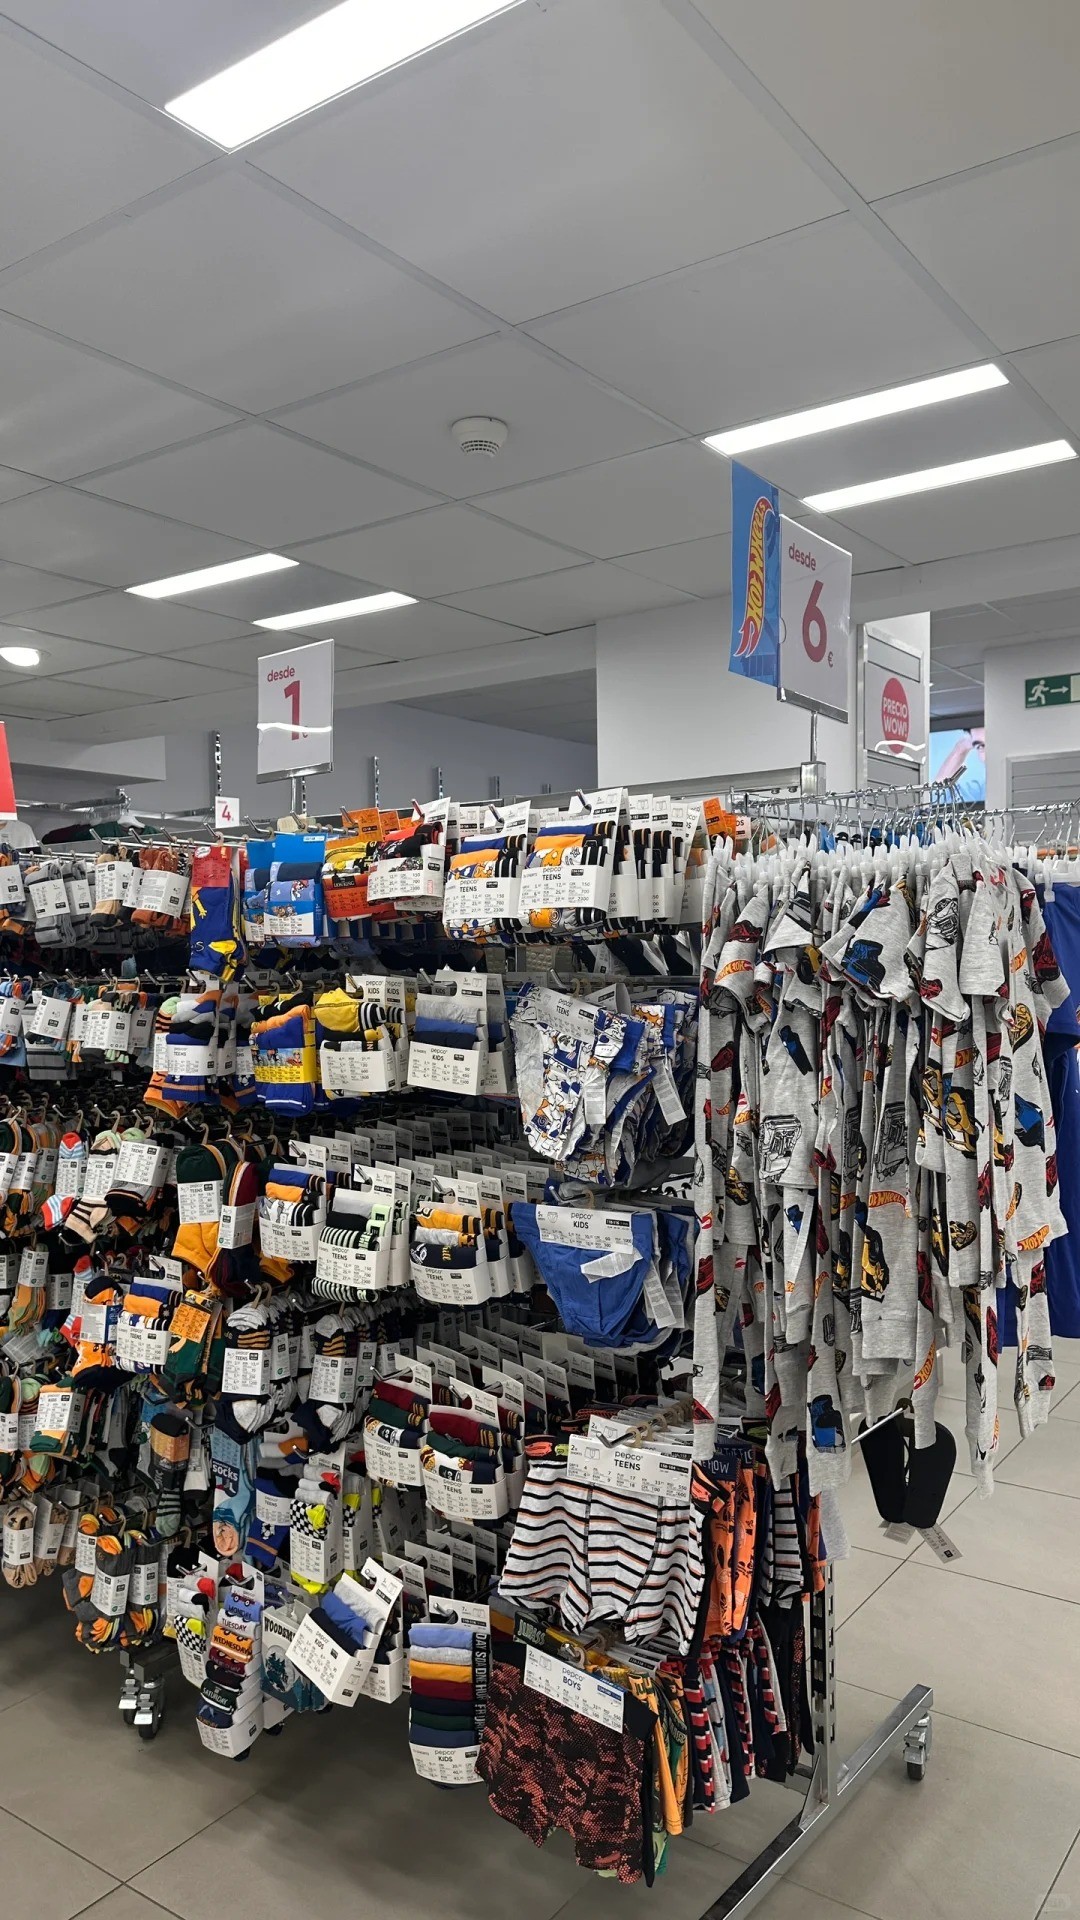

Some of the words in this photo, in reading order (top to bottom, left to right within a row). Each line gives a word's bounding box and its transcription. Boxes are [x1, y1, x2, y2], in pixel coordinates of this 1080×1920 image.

[789, 543, 816, 571] desde
[803, 580, 827, 663] 6
[267, 666, 295, 682] desde
[284, 680, 300, 741] 1
[883, 697, 908, 719] PRECIO
[883, 716, 908, 738] WOW!
[222, 805, 231, 821] 4
[557, 1006, 569, 1017] TEENS
[573, 1221, 589, 1229] KIDS
[377, 1449, 391, 1458] TEENS
[614, 1451, 641, 1461] pepco
[614, 1459, 641, 1470] TEENS
[708, 1460, 729, 1474] FLOW
[443, 1485, 462, 1494] TEENS
[228, 1605, 252, 1619] MONDAY
[222, 1618, 247, 1632] TUESDAY
[214, 1635, 252, 1655] WEDNESDAY
[315, 1639, 324, 1649] KIDS
[562, 1668, 583, 1681] pepco
[563, 1676, 581, 1690] BOYS
[203, 1688, 228, 1705] SATURDAY
